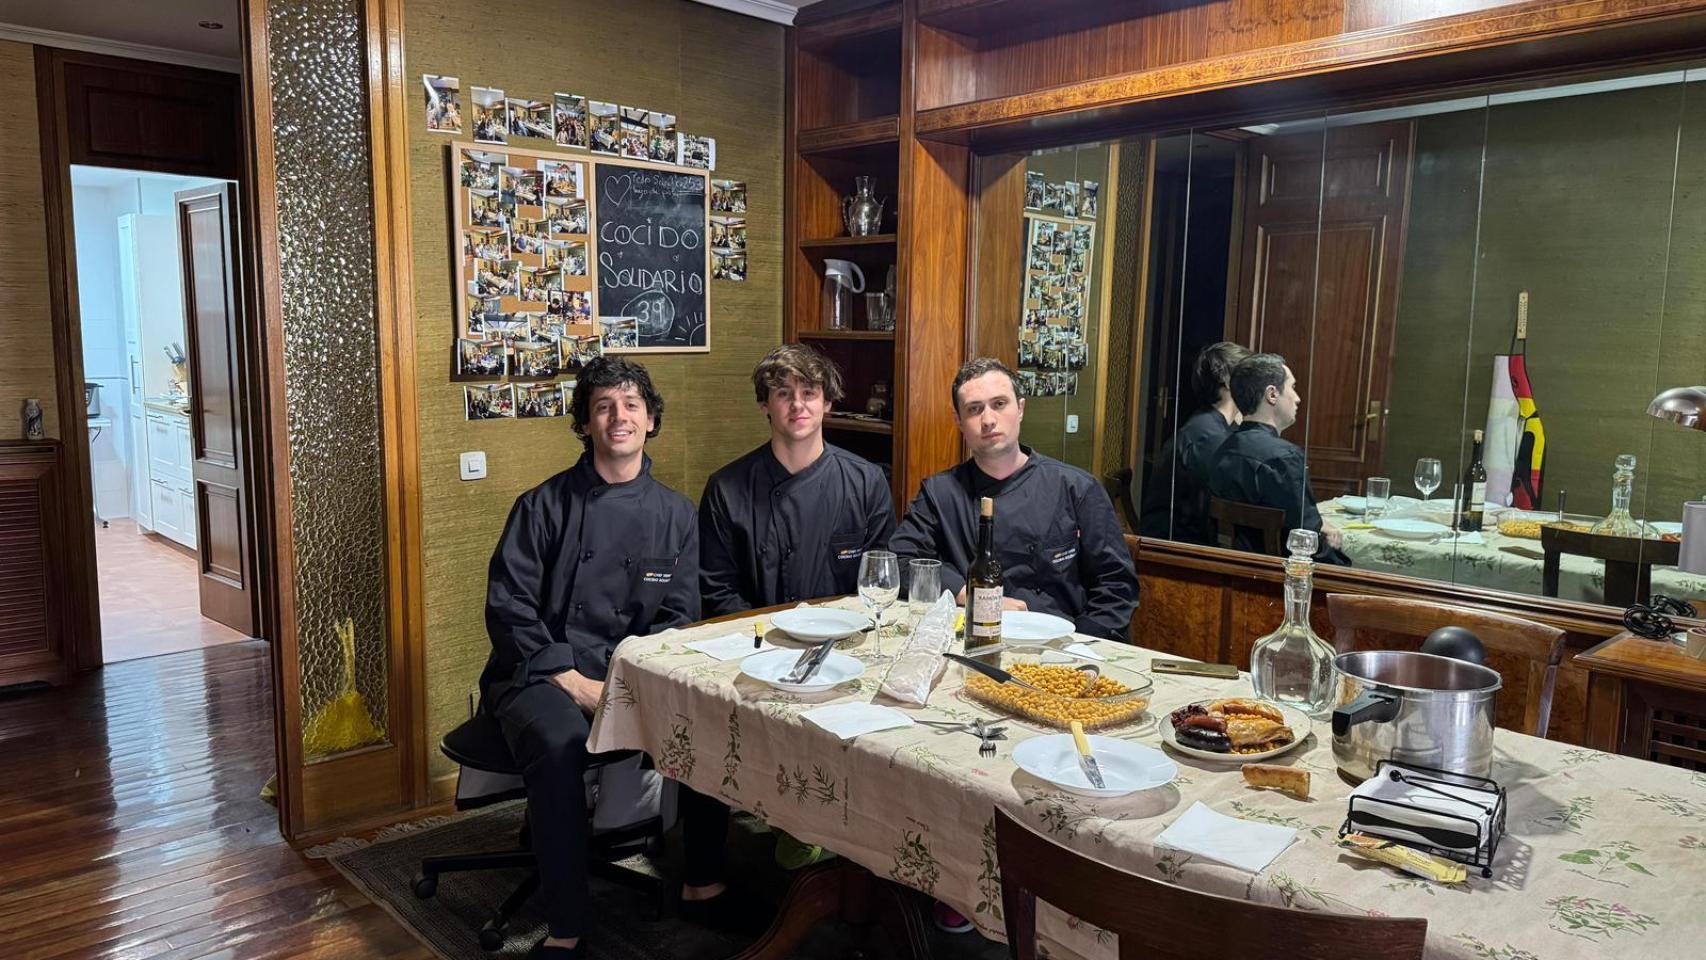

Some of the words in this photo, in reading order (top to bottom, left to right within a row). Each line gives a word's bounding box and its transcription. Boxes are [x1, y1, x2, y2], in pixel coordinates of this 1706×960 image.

[600, 217, 699, 250] COCIDO
[599, 251, 703, 295] SOLIDARIO
[637, 300, 664, 323] 39
